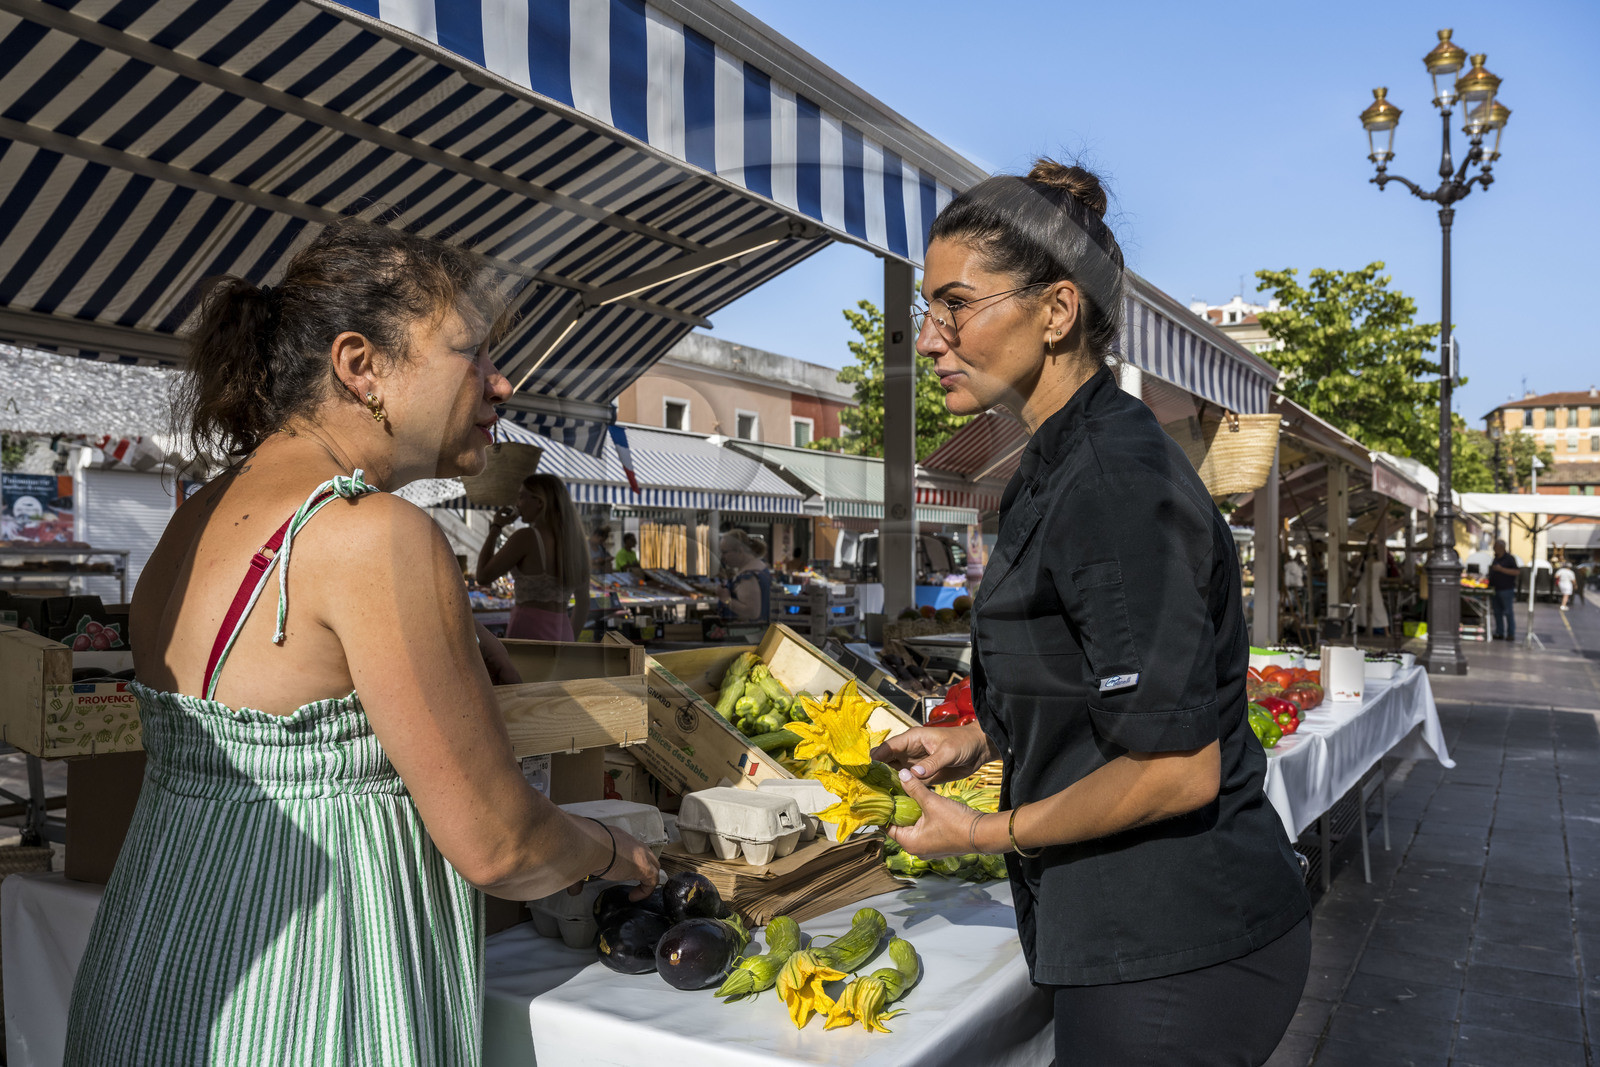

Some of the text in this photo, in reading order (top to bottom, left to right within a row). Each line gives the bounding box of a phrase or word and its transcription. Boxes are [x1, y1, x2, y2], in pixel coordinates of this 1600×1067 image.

[78, 694, 135, 705] PROVENCE
[648, 685, 671, 708] GNARD
[672, 749, 686, 763] des
[685, 759, 709, 782] Sables
